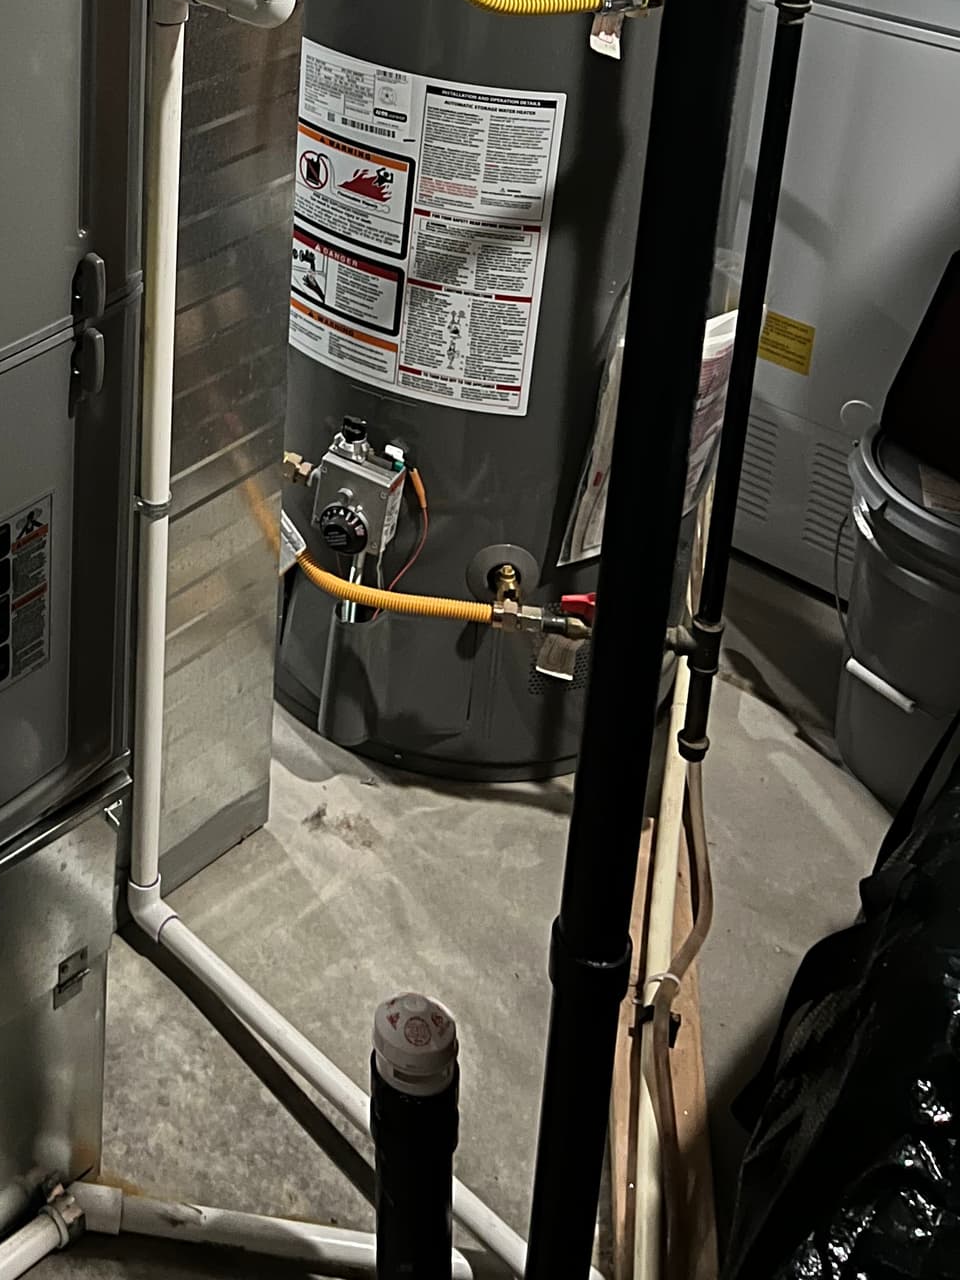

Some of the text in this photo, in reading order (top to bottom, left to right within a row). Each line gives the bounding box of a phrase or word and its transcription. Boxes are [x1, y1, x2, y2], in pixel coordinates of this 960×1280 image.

[328, 139, 372, 161] WARNING
[323, 248, 358, 267] DANGER
[316, 314, 354, 337] WARNING
